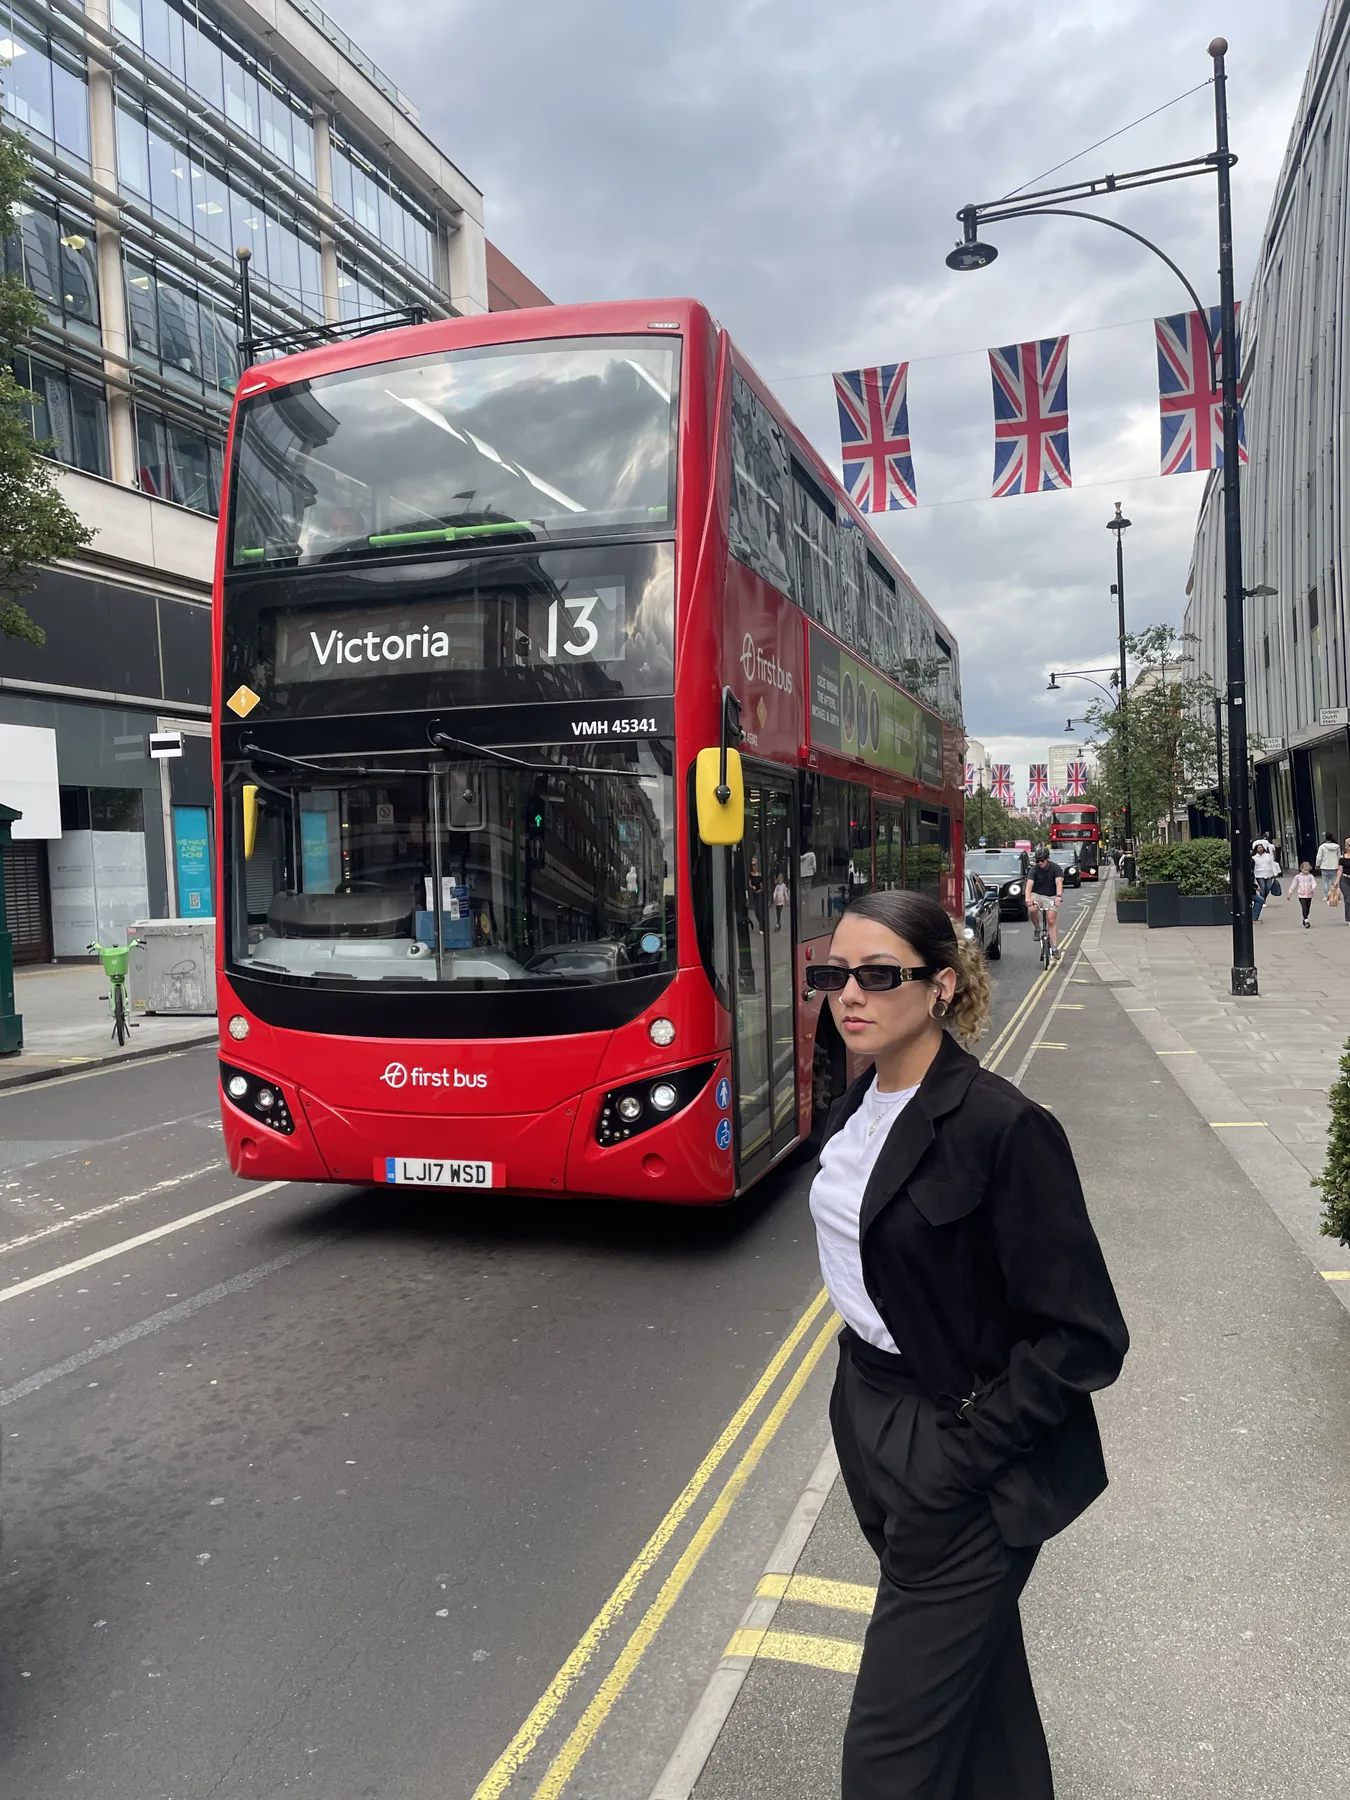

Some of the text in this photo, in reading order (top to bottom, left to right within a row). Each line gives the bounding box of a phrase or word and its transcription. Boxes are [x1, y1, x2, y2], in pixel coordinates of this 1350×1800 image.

[547, 597, 599, 658] 13
[310, 625, 449, 665] Victoria
[757, 647, 776, 687] first
[777, 657, 792, 694] bus
[571, 718, 658, 736] VMH 45341
[410, 1067, 488, 1088] first bus
[403, 1162, 486, 1184] LJ17 WSD
